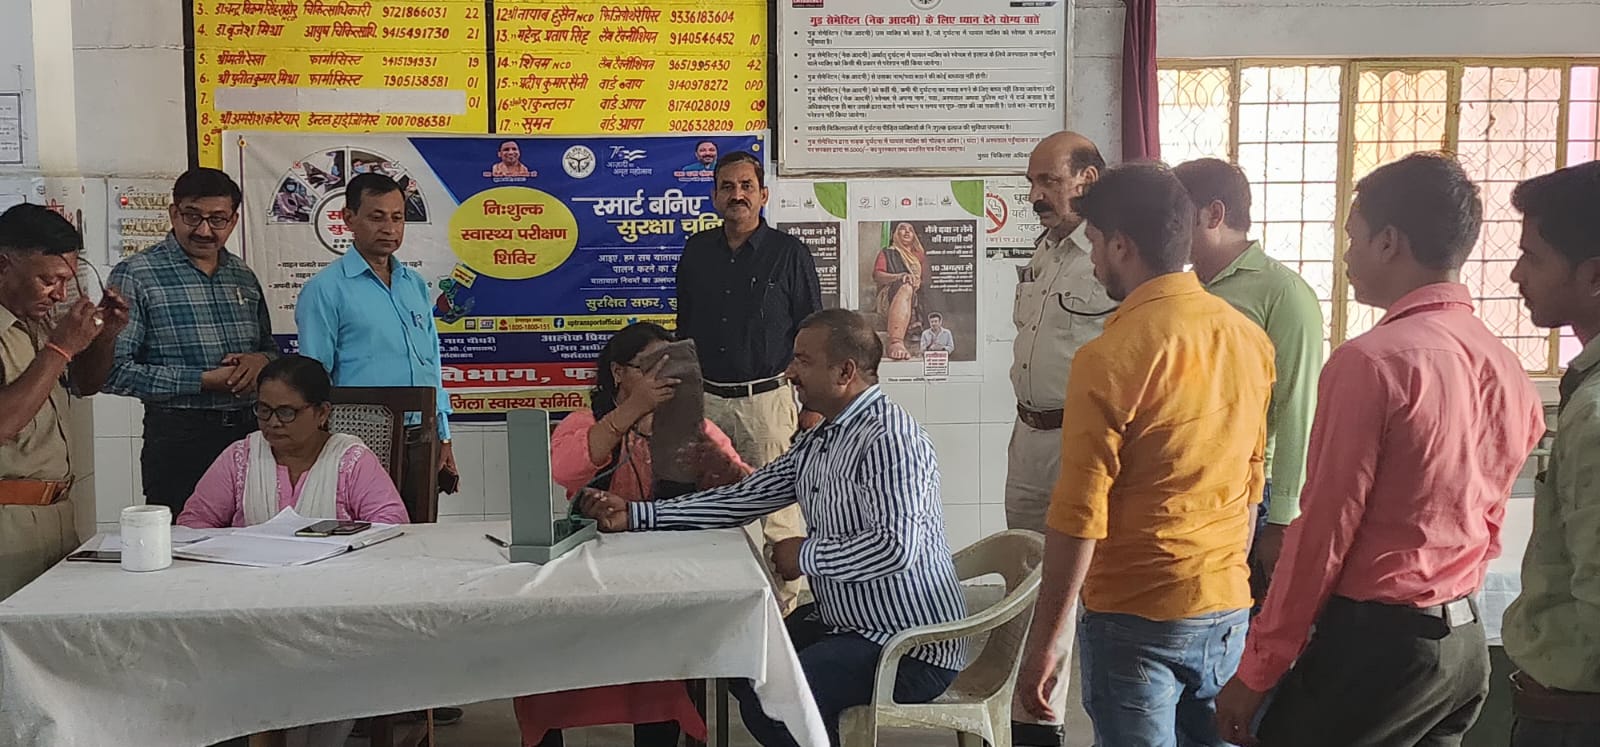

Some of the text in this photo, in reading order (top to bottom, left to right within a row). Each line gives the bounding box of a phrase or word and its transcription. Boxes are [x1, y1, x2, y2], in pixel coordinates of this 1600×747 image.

[382, 6, 447, 18] 9721866031
[465, 7, 479, 19] 22
[576, 14, 595, 22] NCD
[670, 10, 735, 23] 9336183604
[810, 16, 823, 27] गुड
[197, 23, 208, 36] 4.
[382, 27, 449, 39] 9415491730
[467, 27, 479, 40] 21
[670, 32, 735, 45] 9140546452
[750, 33, 760, 45] 10
[198, 53, 208, 64] 5.
[552, 62, 571, 70] NCD
[747, 60, 762, 71] 42
[200, 73, 209, 83] 6.
[384, 75, 449, 87] 7905138581
[467, 77, 479, 88] 01
[668, 80, 728, 91] 9140978272
[200, 93, 480, 108] 7. 01
[668, 99, 730, 112] 8174028019
[201, 113, 212, 125] 8.
[386, 115, 451, 127] 7007086381
[522, 117, 554, 134] सुमन
[669, 120, 734, 132] 9026328209
[202, 133, 214, 146] 9.
[583, 189, 709, 216] स्मार्ट बनिए
[461, 224, 568, 241] स्वास्थ्य परीक्षण
[612, 218, 675, 243] सुरक्षा
[493, 249, 537, 265] शिविर
[653, 254, 683, 262] याताया
[585, 295, 627, 311] सुरक्षित
[488, 398, 535, 410] स्वास्थ्य
